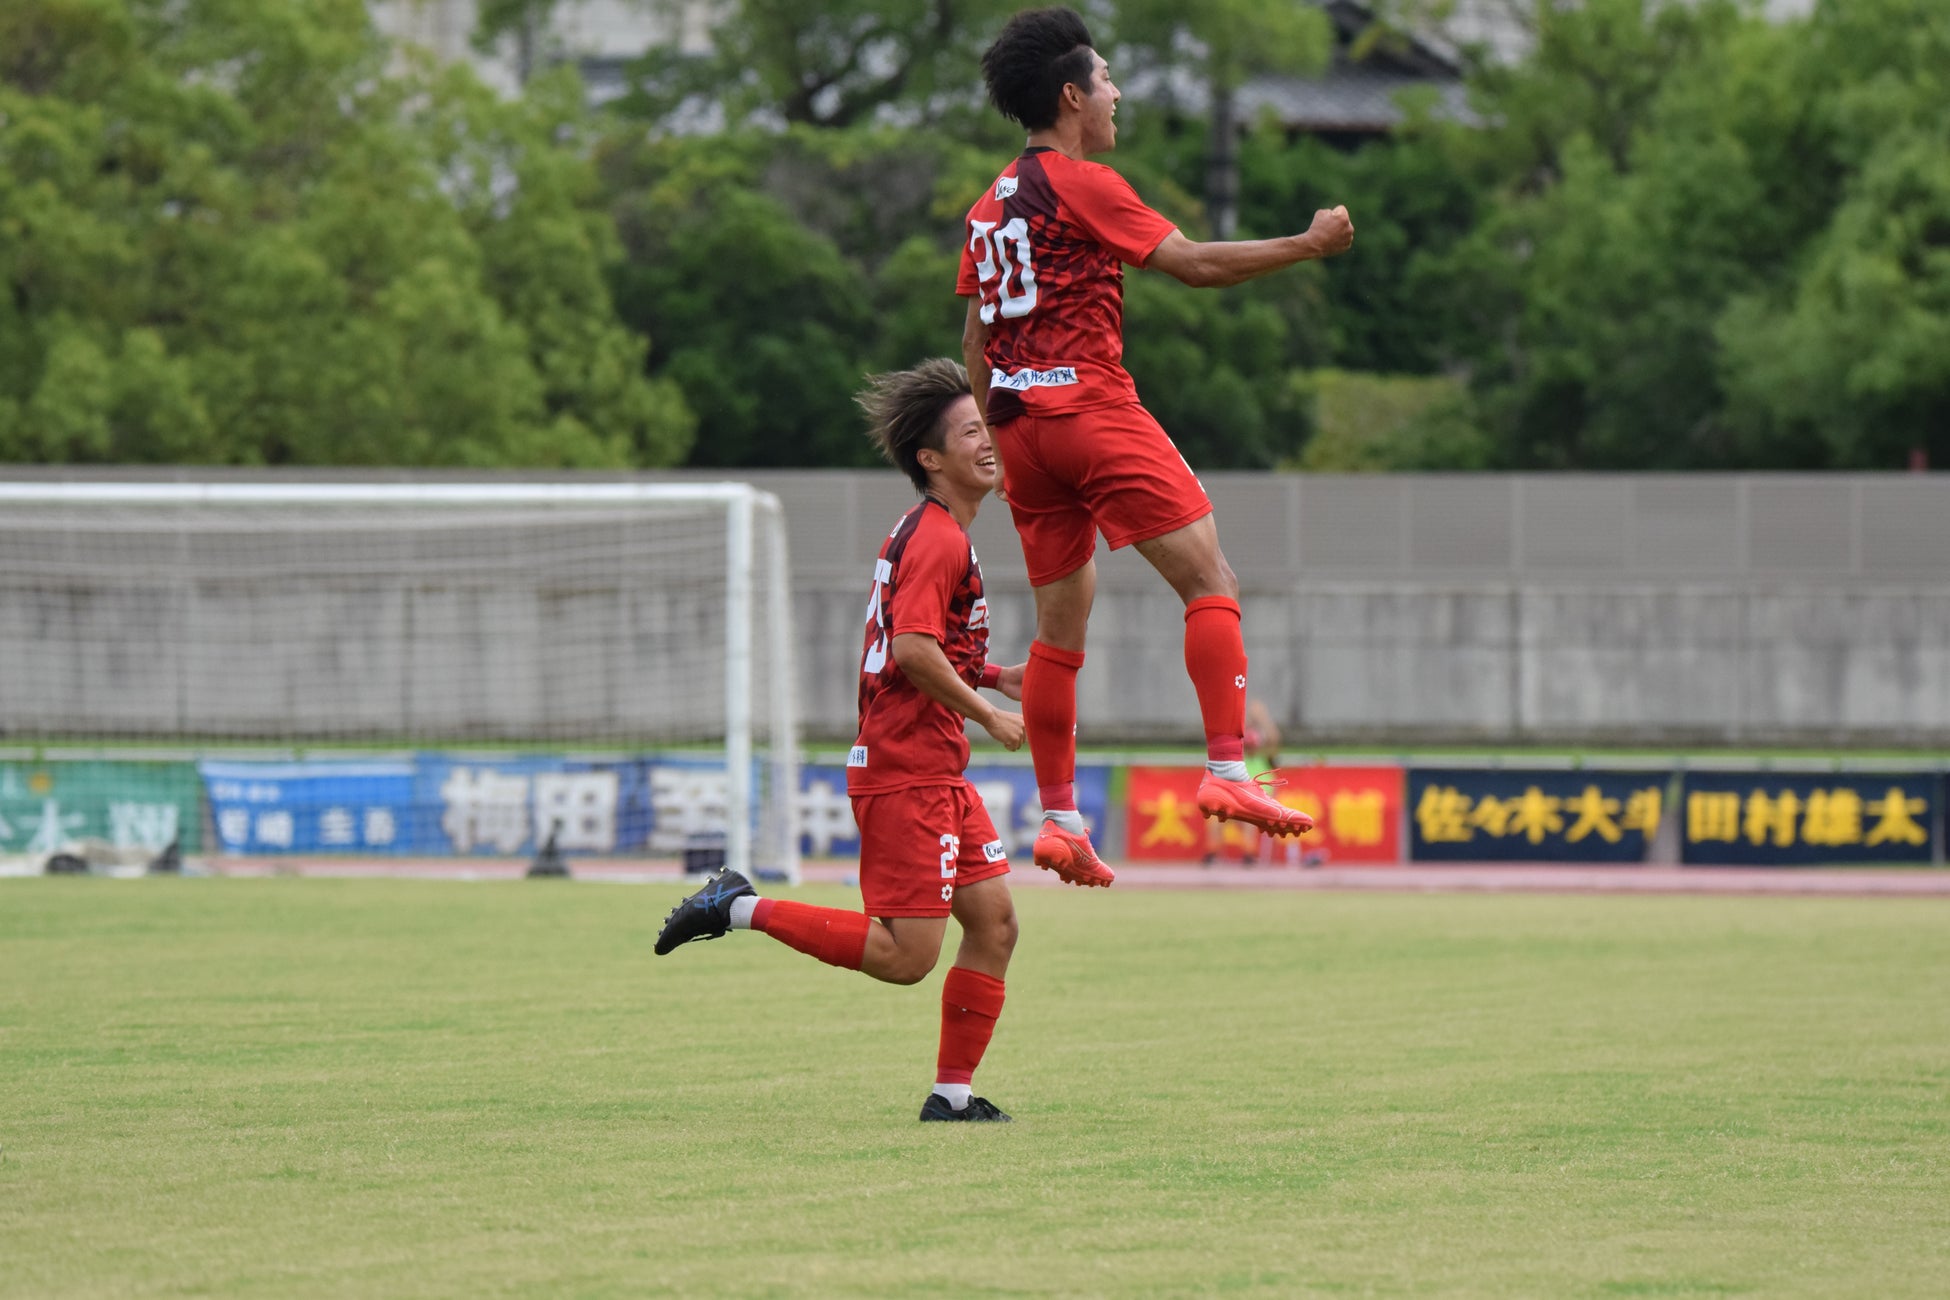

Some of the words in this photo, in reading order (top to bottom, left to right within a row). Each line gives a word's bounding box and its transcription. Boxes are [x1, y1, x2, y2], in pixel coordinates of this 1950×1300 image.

[969, 217, 1038, 326] 20
[1687, 787, 1928, 847] 田村雄太
